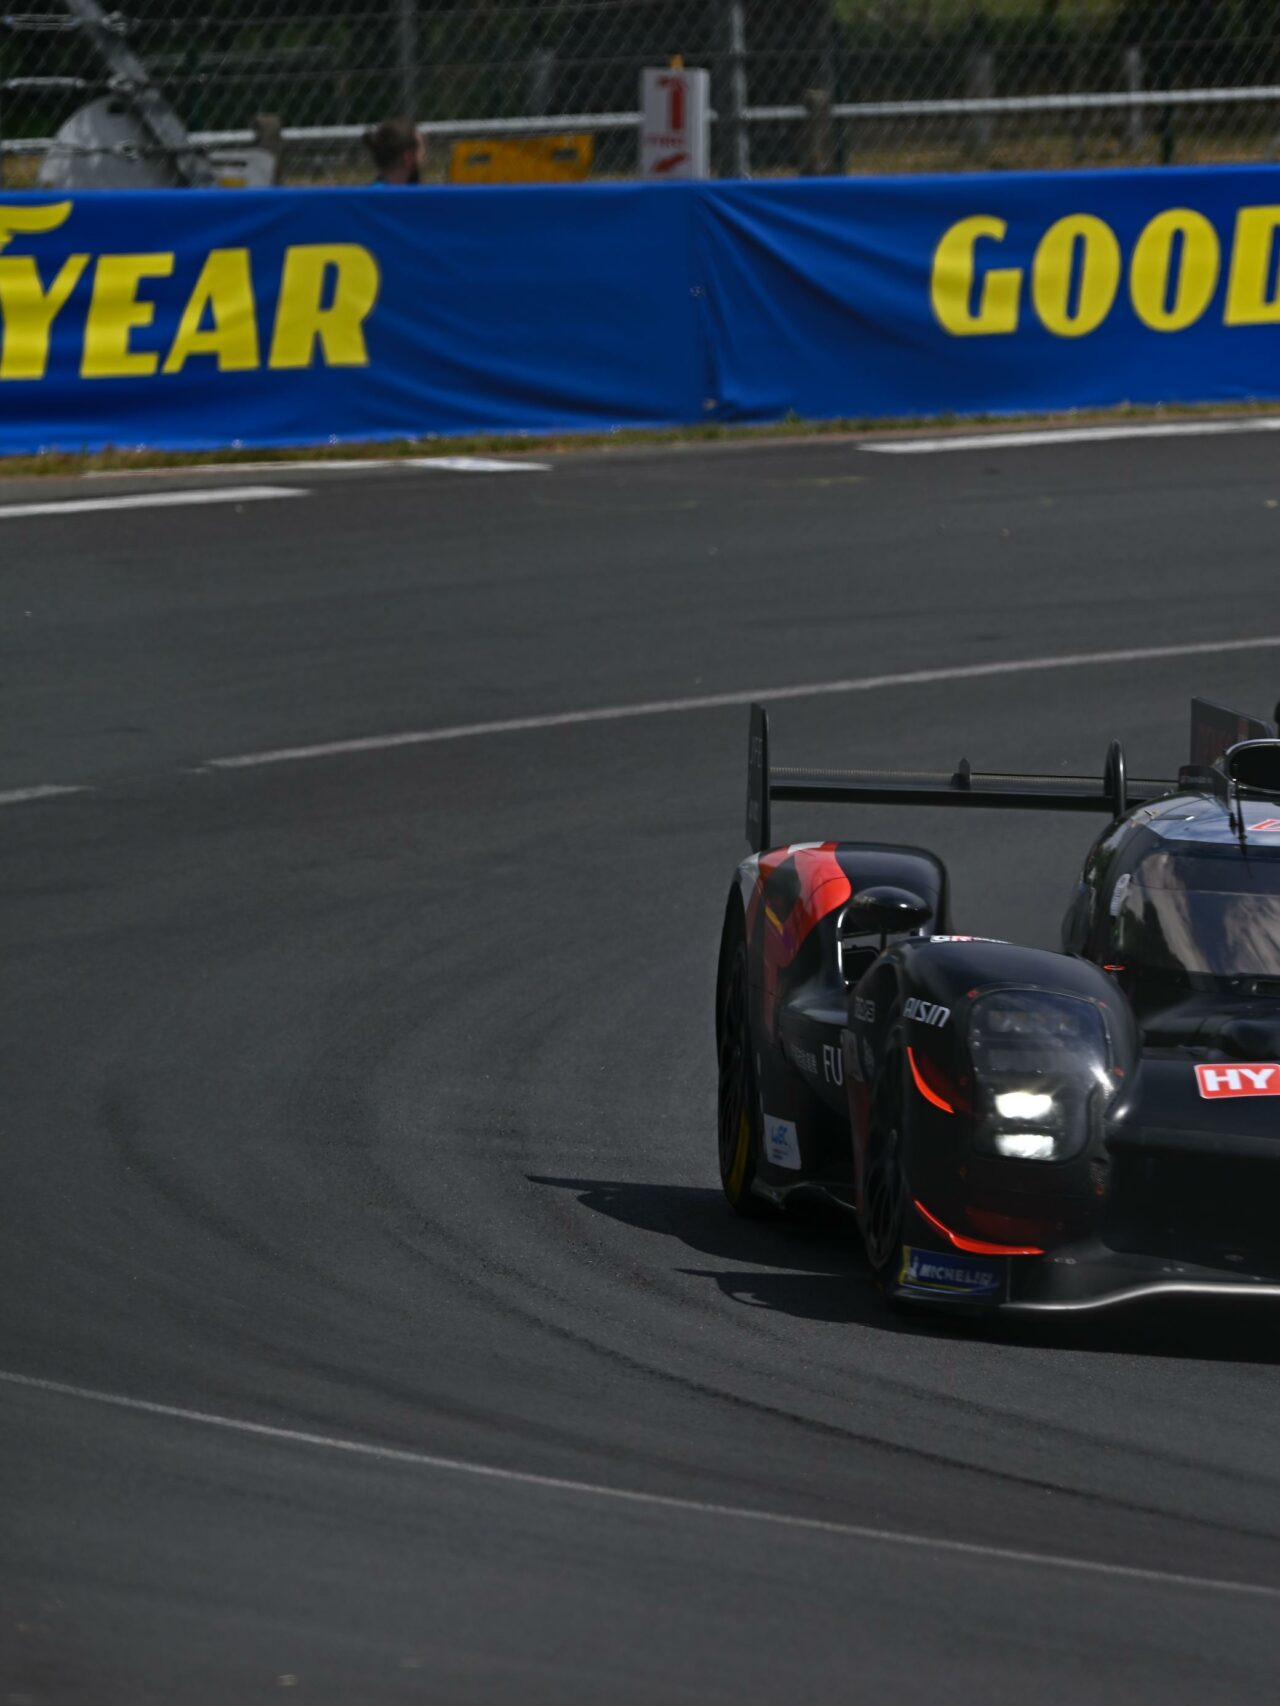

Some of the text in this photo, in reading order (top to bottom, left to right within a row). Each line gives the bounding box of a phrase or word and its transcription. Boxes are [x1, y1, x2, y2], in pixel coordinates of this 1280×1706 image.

[903, 997, 951, 1028] AISIN
[1202, 1068, 1277, 1092] HY
[918, 1263, 995, 1287] MICHELIN
